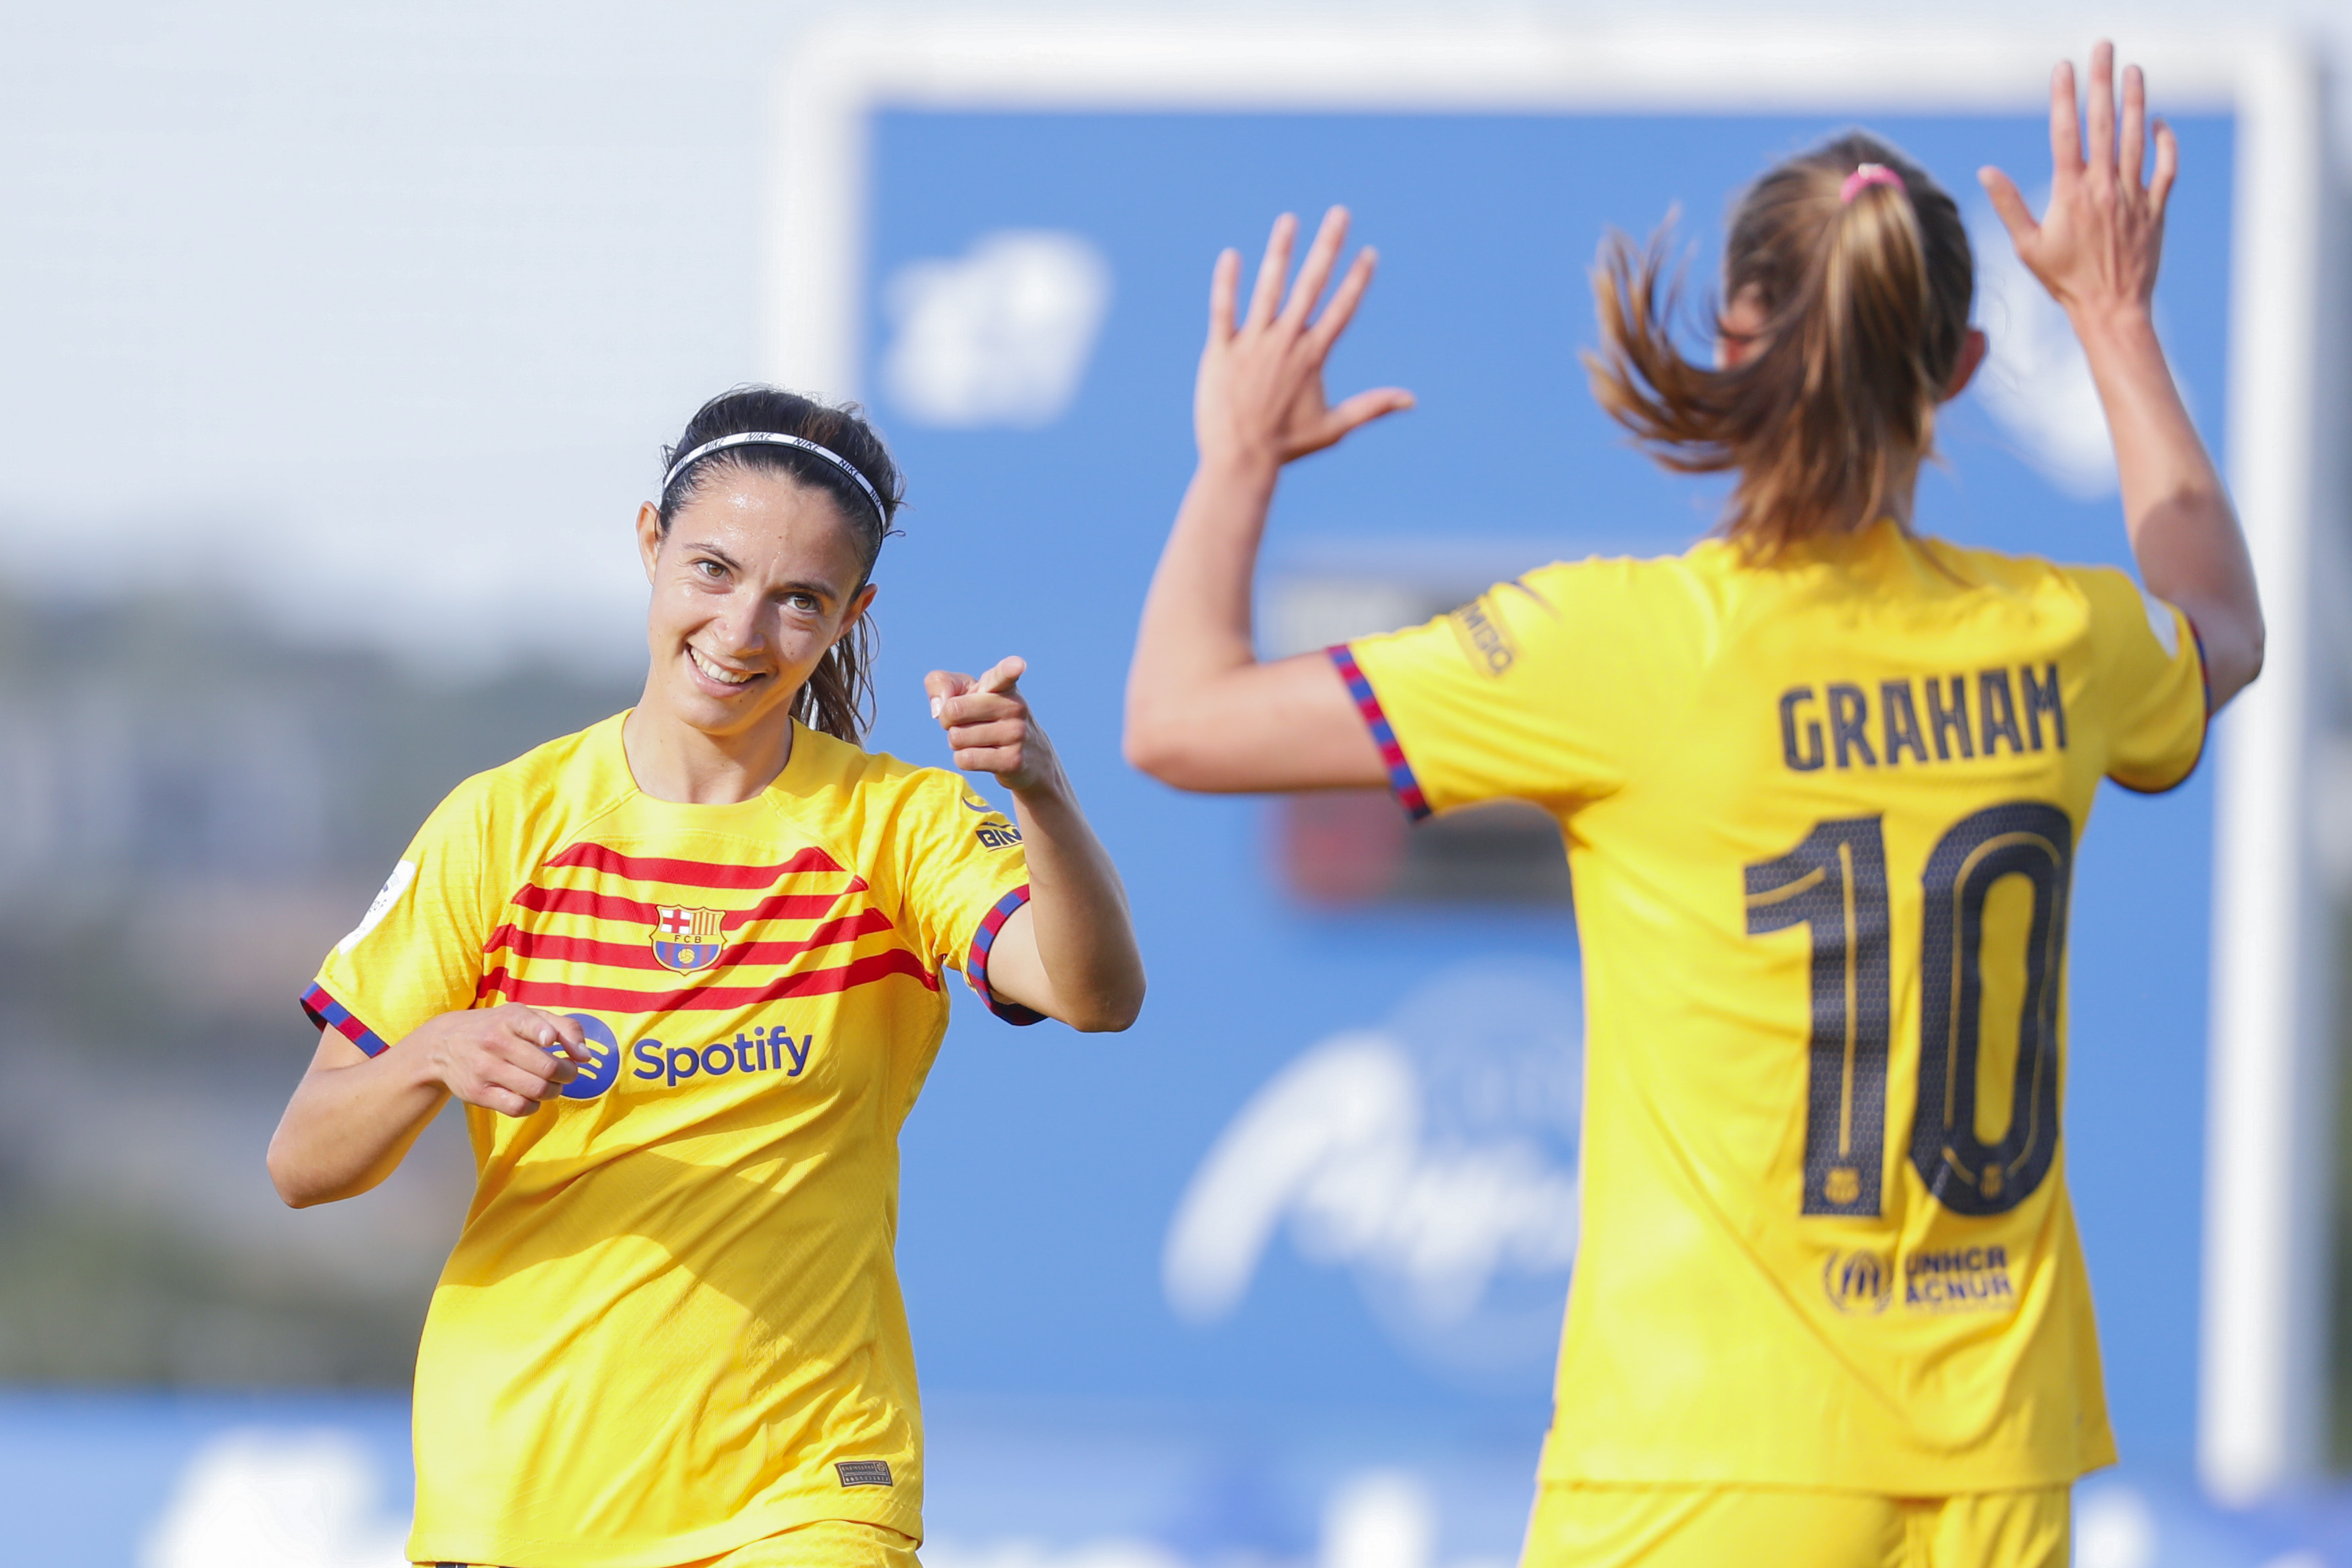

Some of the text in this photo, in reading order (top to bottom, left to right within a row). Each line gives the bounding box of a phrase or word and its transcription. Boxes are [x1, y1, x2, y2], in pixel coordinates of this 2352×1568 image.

[793, 436, 822, 453] NIKE
[838, 459, 859, 479] NIKE
[1779, 663, 2067, 772] GRAHAM
[1743, 799, 2073, 1218] 10
[632, 1025, 812, 1087] Spotify
